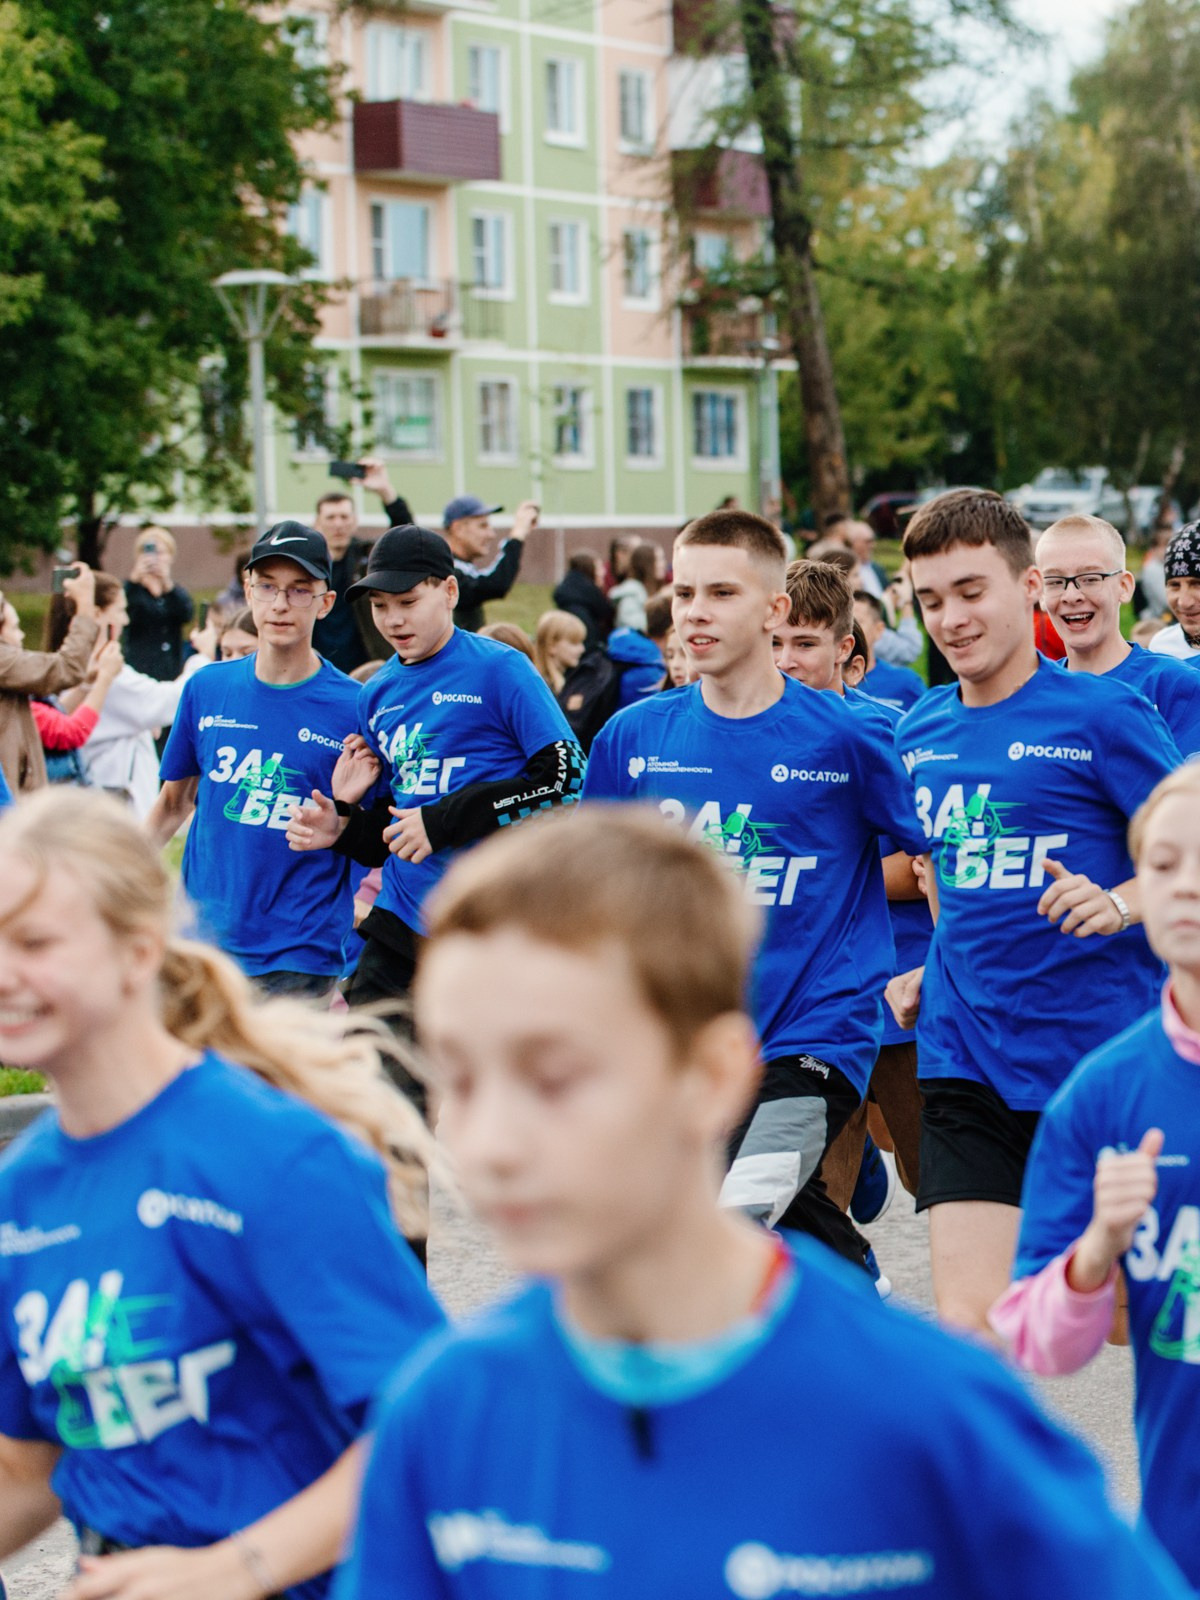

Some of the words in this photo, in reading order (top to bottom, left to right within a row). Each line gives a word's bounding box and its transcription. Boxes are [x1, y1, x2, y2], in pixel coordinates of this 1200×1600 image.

[442, 693, 483, 704] РОСАТОМ
[311, 733, 346, 751] РОСАТО
[1025, 745, 1092, 762] РОСАТОМ
[209, 746, 284, 789] ЗА!
[398, 757, 466, 795] БЕГ
[790, 768, 849, 783] РОСАТОМ
[493, 795, 521, 809] USA
[915, 783, 992, 838] ЗА!
[955, 833, 1069, 889] БЕГ
